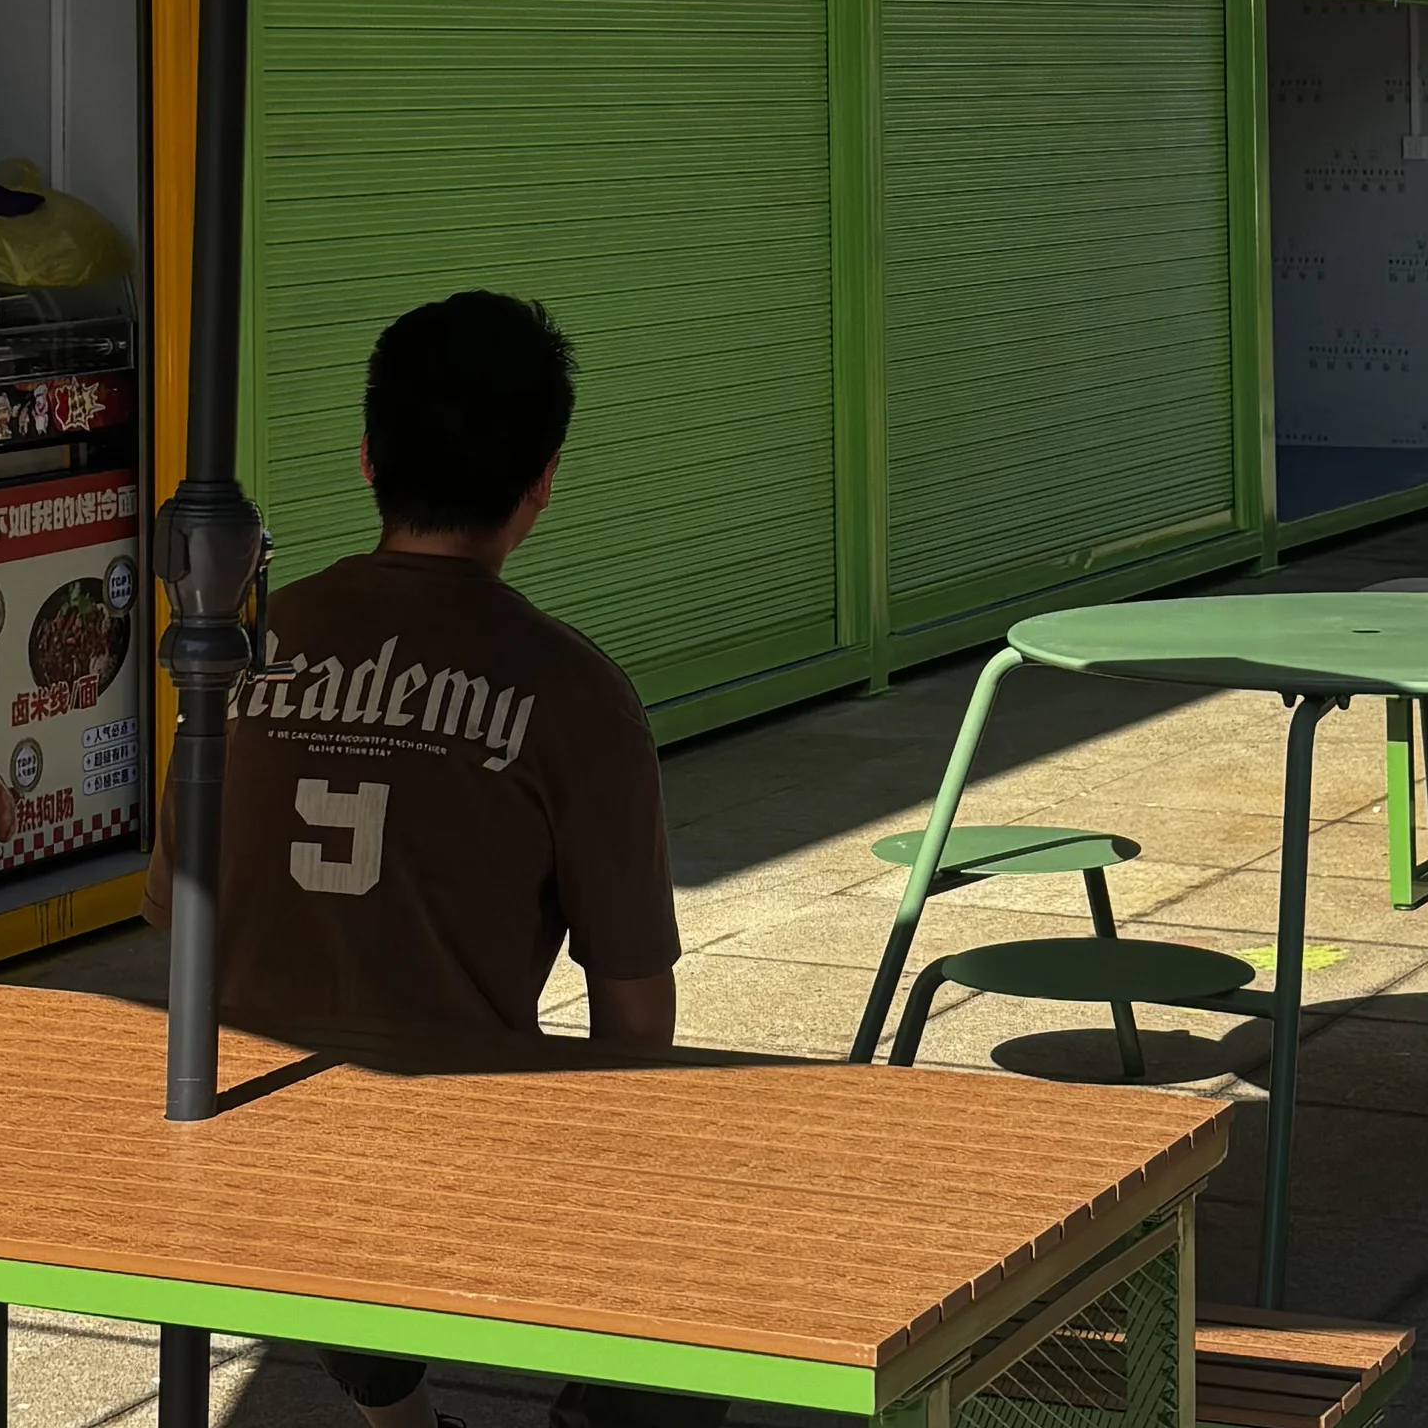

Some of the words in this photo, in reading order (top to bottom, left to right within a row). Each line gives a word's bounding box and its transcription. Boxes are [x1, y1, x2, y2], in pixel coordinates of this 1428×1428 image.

[11, 675, 98, 727] 卤米线/面
[17, 787, 74, 833] 热狗肠
